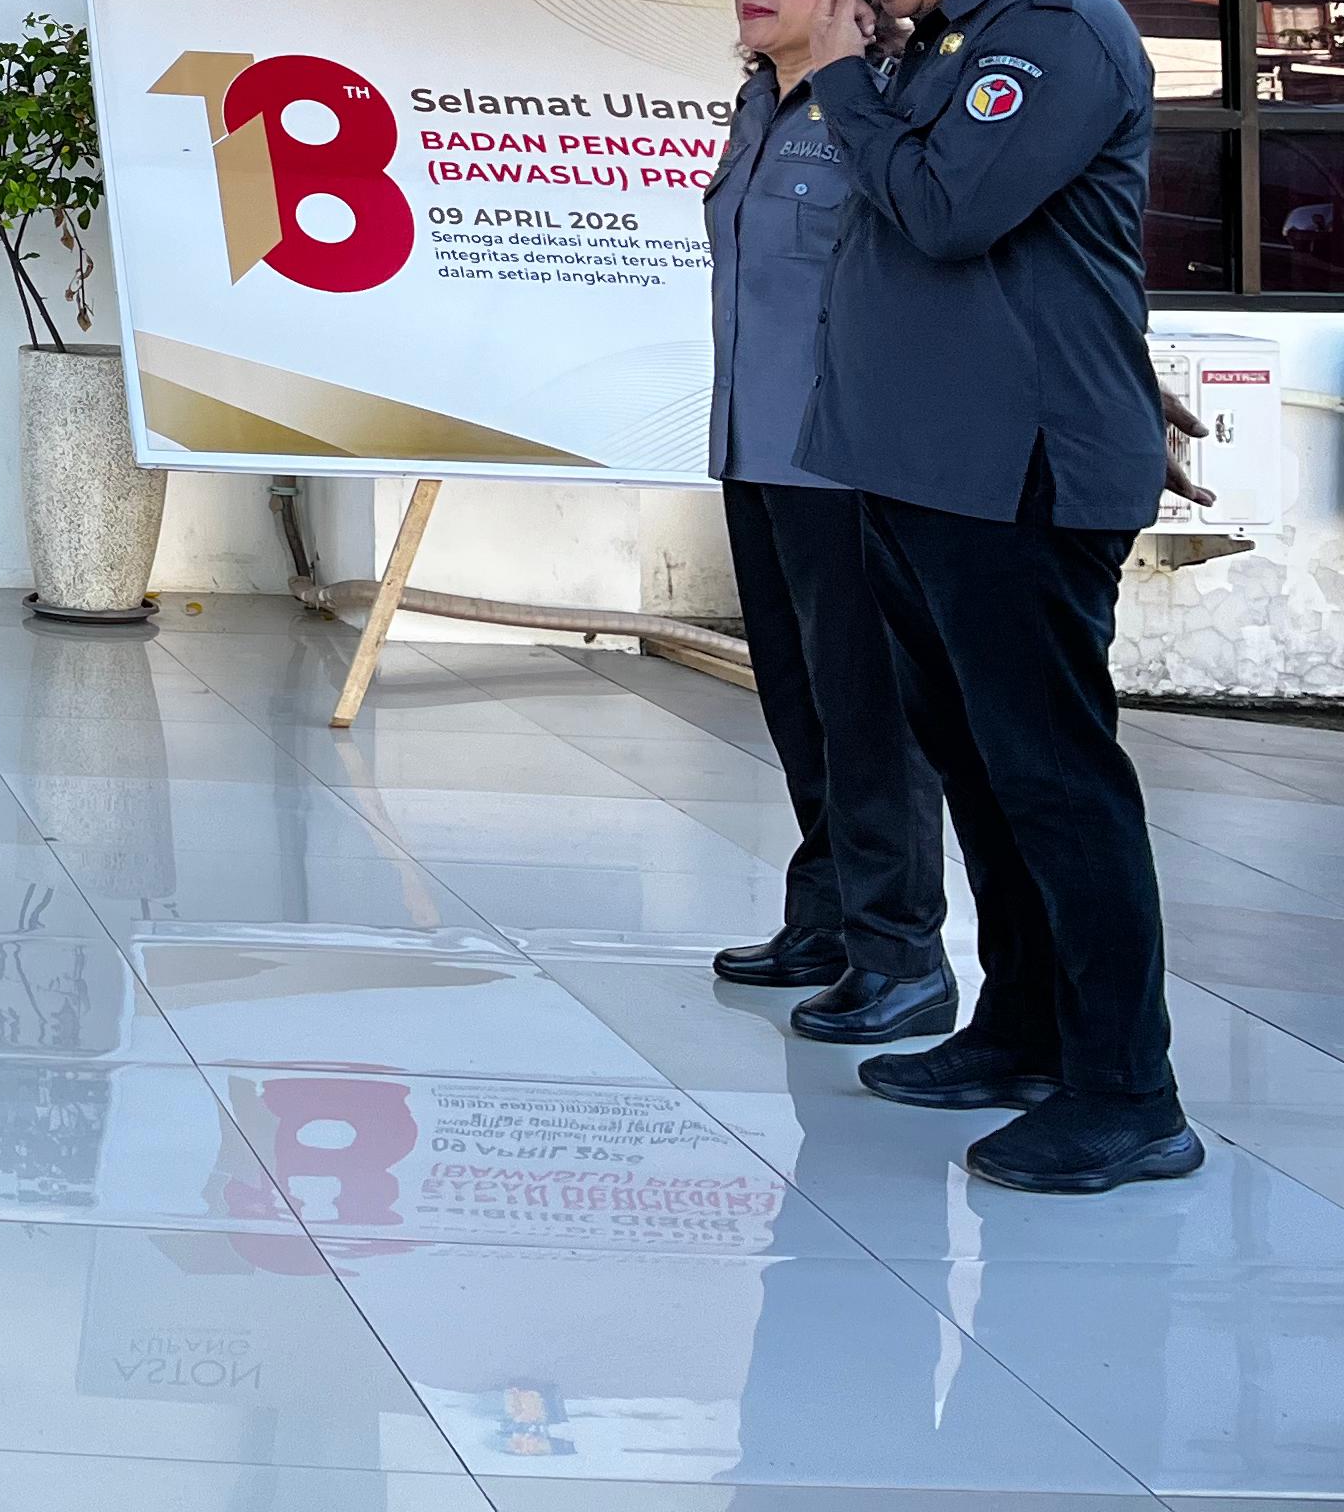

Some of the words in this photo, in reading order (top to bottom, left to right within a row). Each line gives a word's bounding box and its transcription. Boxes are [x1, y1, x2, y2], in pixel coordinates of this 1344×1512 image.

[342, 85, 371, 100] TH
[410, 87, 592, 118] Selamat
[603, 92, 731, 127] Ulang
[420, 130, 547, 154] BADAN
[428, 160, 629, 192] (BAWASLU)
[428, 206, 463, 225] 09
[474, 208, 562, 229] APRIL
[568, 211, 639, 231] 2026
[432, 231, 504, 247] Semoga
[509, 233, 582, 248] dedikasi
[588, 236, 640, 250] untuk
[435, 247, 520, 265] integritas
[524, 250, 617, 266] demokrasi
[622, 255, 668, 267] terus
[672, 255, 714, 268] berk
[438, 266, 493, 280] dalam
[499, 268, 552, 284] setiap
[556, 269, 666, 287] langkahnya.
